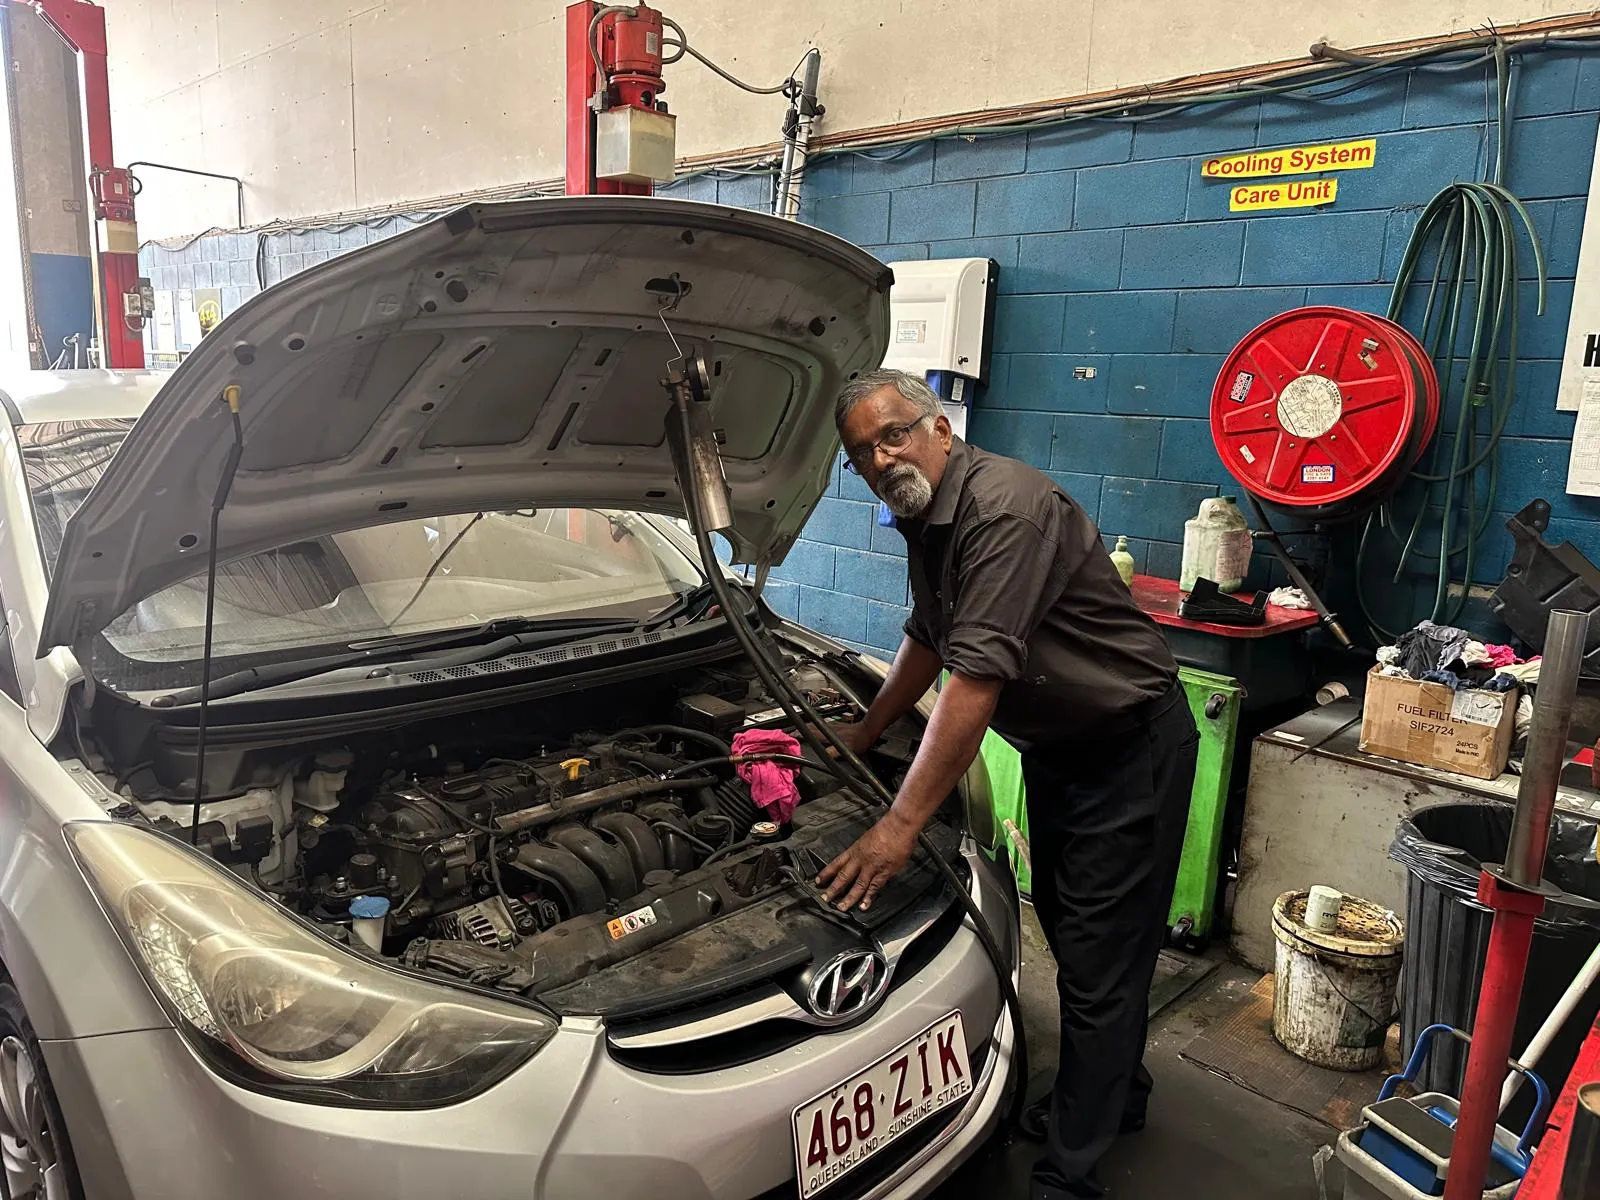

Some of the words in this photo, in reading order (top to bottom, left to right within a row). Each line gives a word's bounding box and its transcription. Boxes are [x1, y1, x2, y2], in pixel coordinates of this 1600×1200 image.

[1206, 156, 1283, 175] Cooling
[1290, 146, 1371, 170] System
[1235, 188, 1280, 204] Care
[1288, 182, 1330, 201] Unit
[1397, 703, 1426, 717] FUEL
[1409, 720, 1454, 736] SIF2724
[1456, 740, 1479, 750] 24PCS
[810, 1137, 878, 1190] QUEENSLAND
[888, 1100, 933, 1138] SUNSHINE
[937, 1081, 966, 1106] STATE
